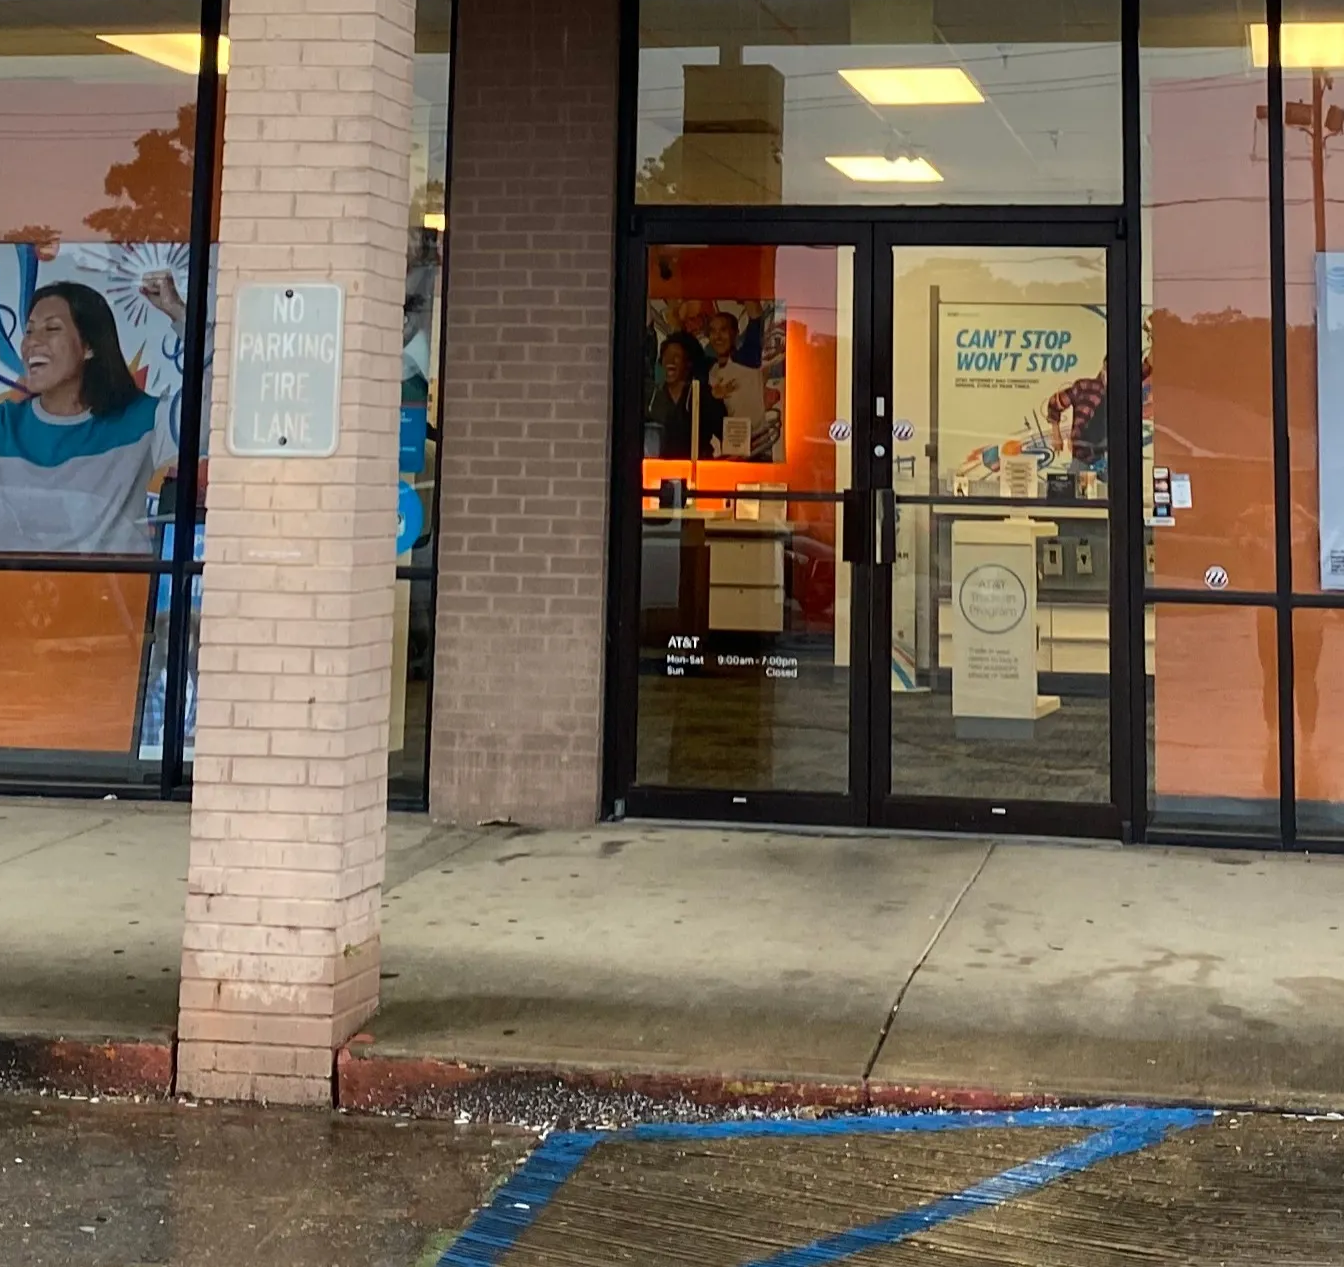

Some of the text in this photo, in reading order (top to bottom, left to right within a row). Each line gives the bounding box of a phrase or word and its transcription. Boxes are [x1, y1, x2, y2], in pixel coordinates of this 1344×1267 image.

[273, 292, 305, 325] NO
[240, 333, 335, 364] PARKING
[956, 329, 1072, 350] CAN'T STOP
[957, 351, 1079, 373] WON'T STOP
[260, 372, 310, 403] FIRE
[253, 411, 313, 444] LANE
[668, 635, 700, 649] AT&T
[667, 665, 798, 678] Sun Closed
